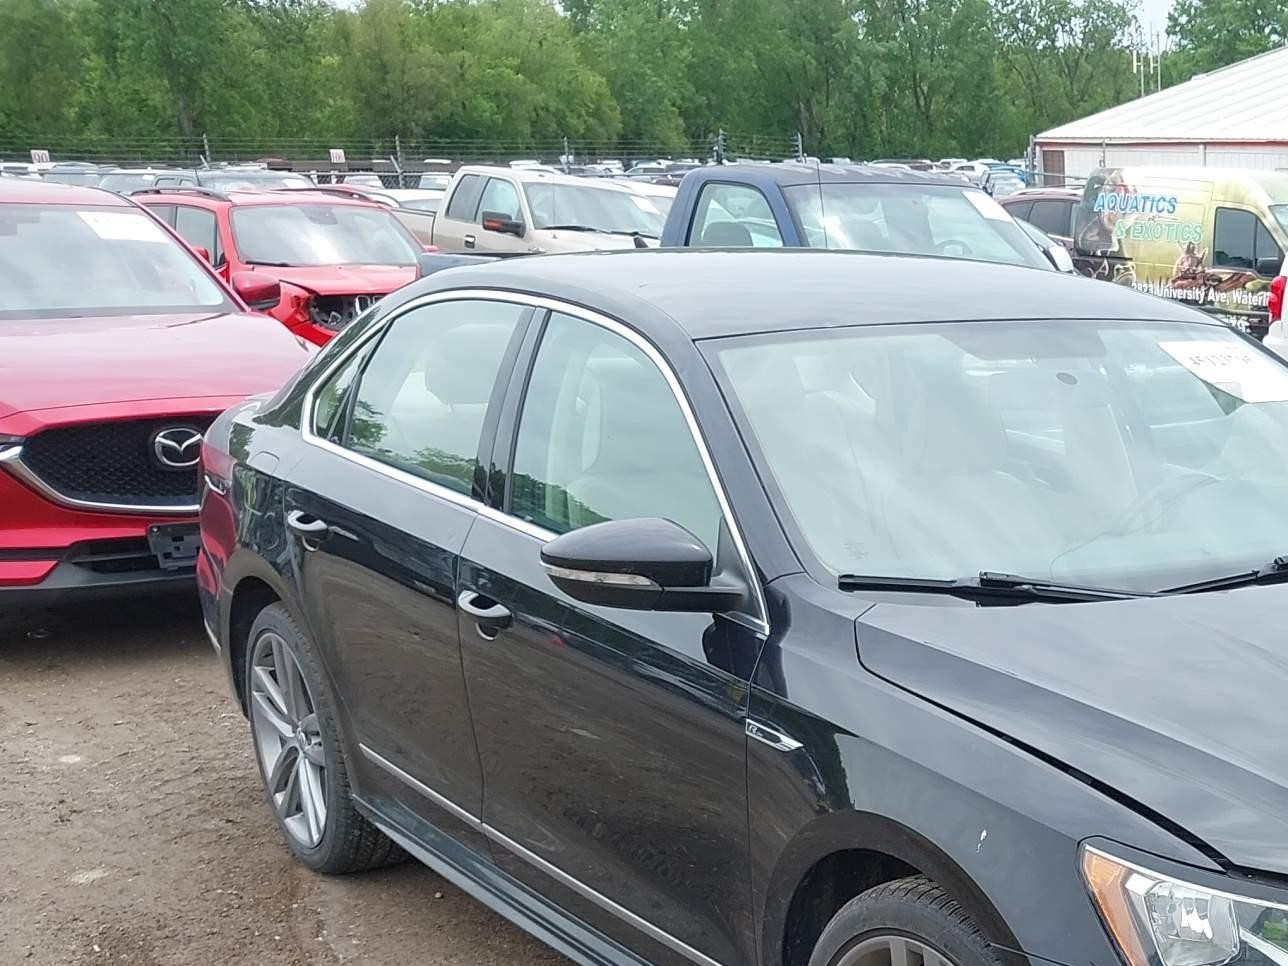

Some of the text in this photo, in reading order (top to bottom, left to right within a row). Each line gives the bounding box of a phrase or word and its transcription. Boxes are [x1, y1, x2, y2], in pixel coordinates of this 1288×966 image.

[1093, 192, 1178, 213] AQUATICS
[1115, 219, 1204, 243] & EXOTICS
[1157, 286, 1204, 304] University
[1207, 291, 1230, 306] Ave,
